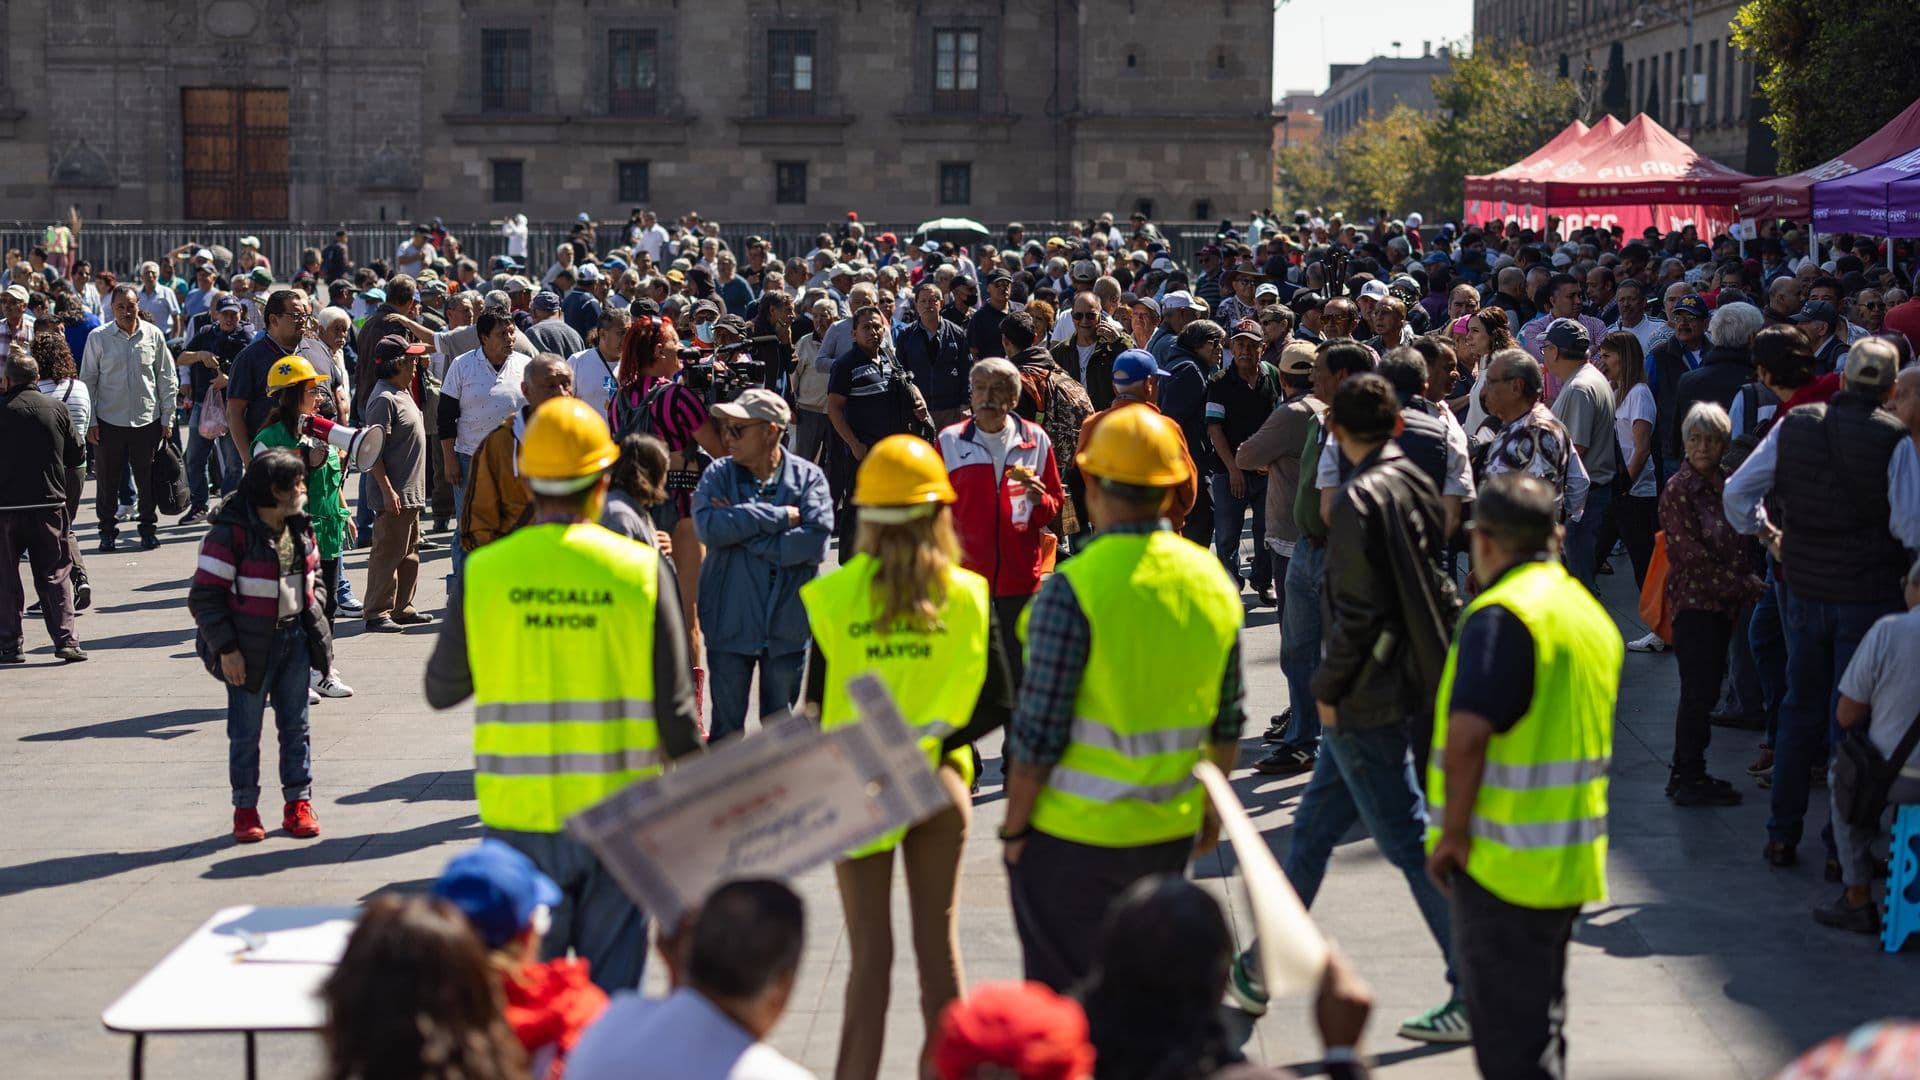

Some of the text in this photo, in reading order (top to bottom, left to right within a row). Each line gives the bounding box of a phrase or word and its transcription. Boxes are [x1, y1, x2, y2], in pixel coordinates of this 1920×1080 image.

[509, 588, 614, 605] OFICIALIA
[524, 613, 597, 629] MAYOR
[866, 644, 932, 659] MAYOR
